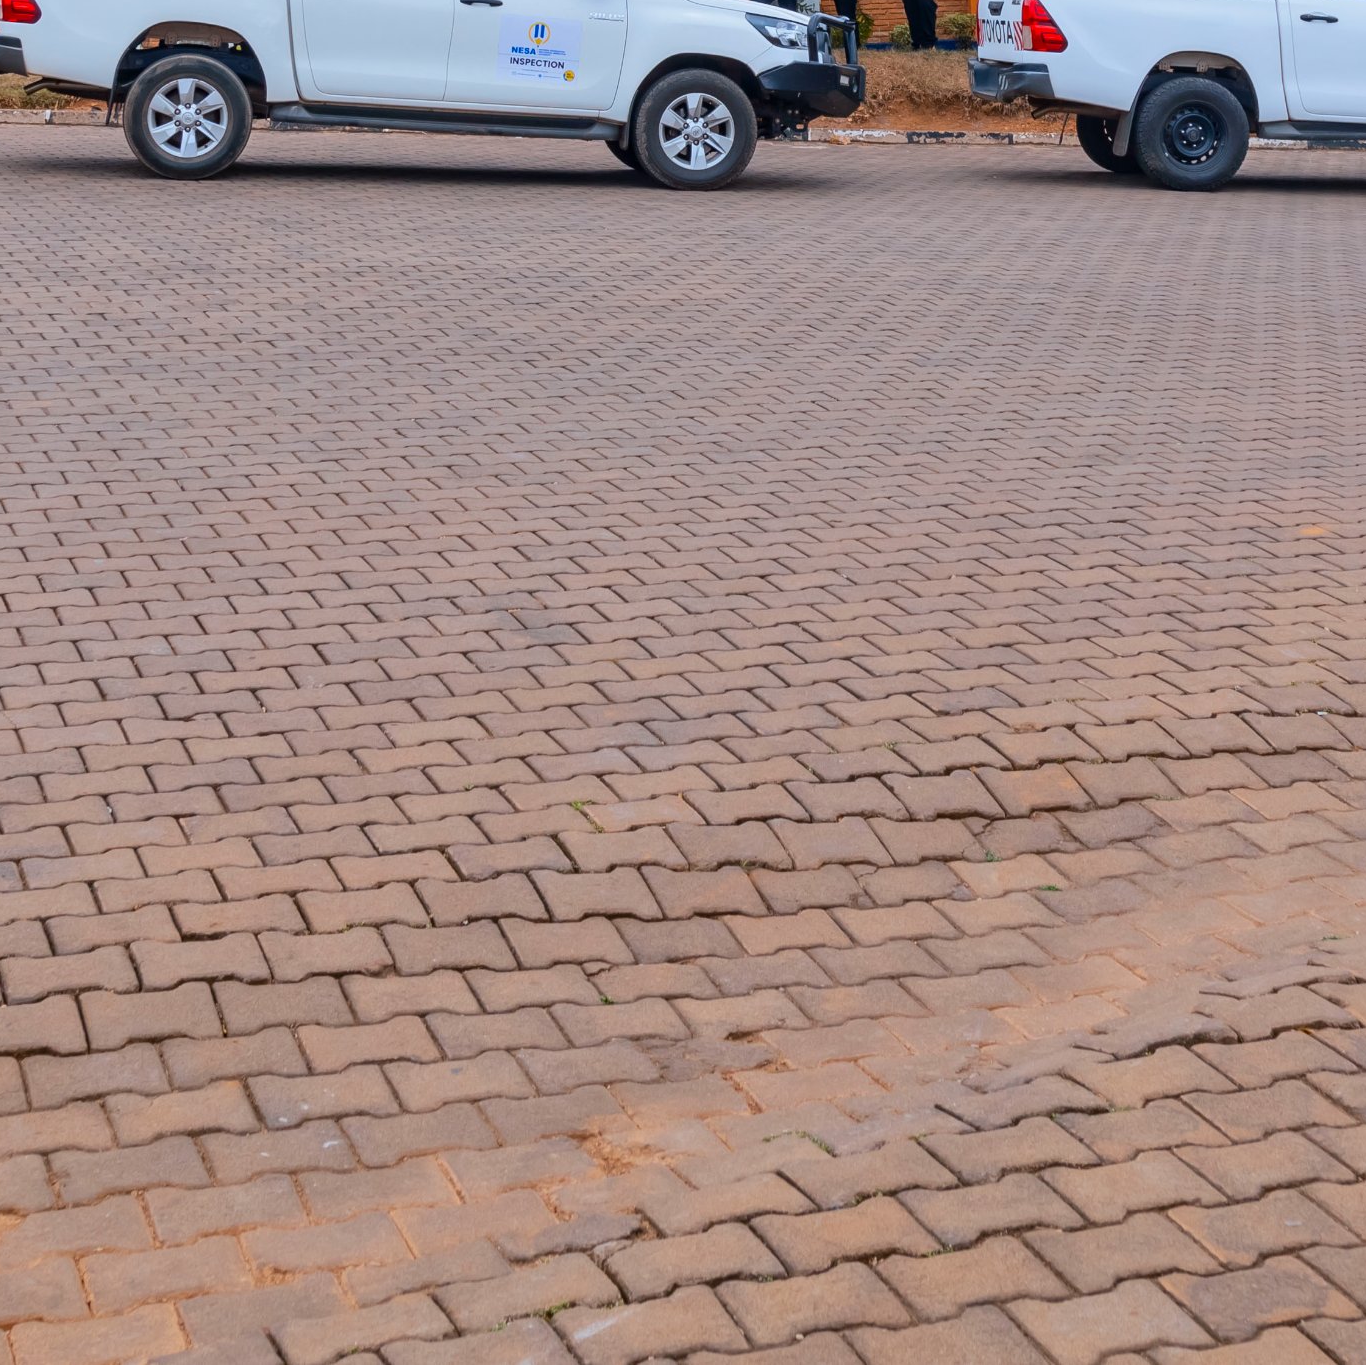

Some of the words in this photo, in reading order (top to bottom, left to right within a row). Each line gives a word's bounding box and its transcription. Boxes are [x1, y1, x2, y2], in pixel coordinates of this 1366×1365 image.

[981, 19, 1014, 45] TOYOTA
[511, 46, 536, 55] NESA
[510, 56, 565, 70] INSPECTION
